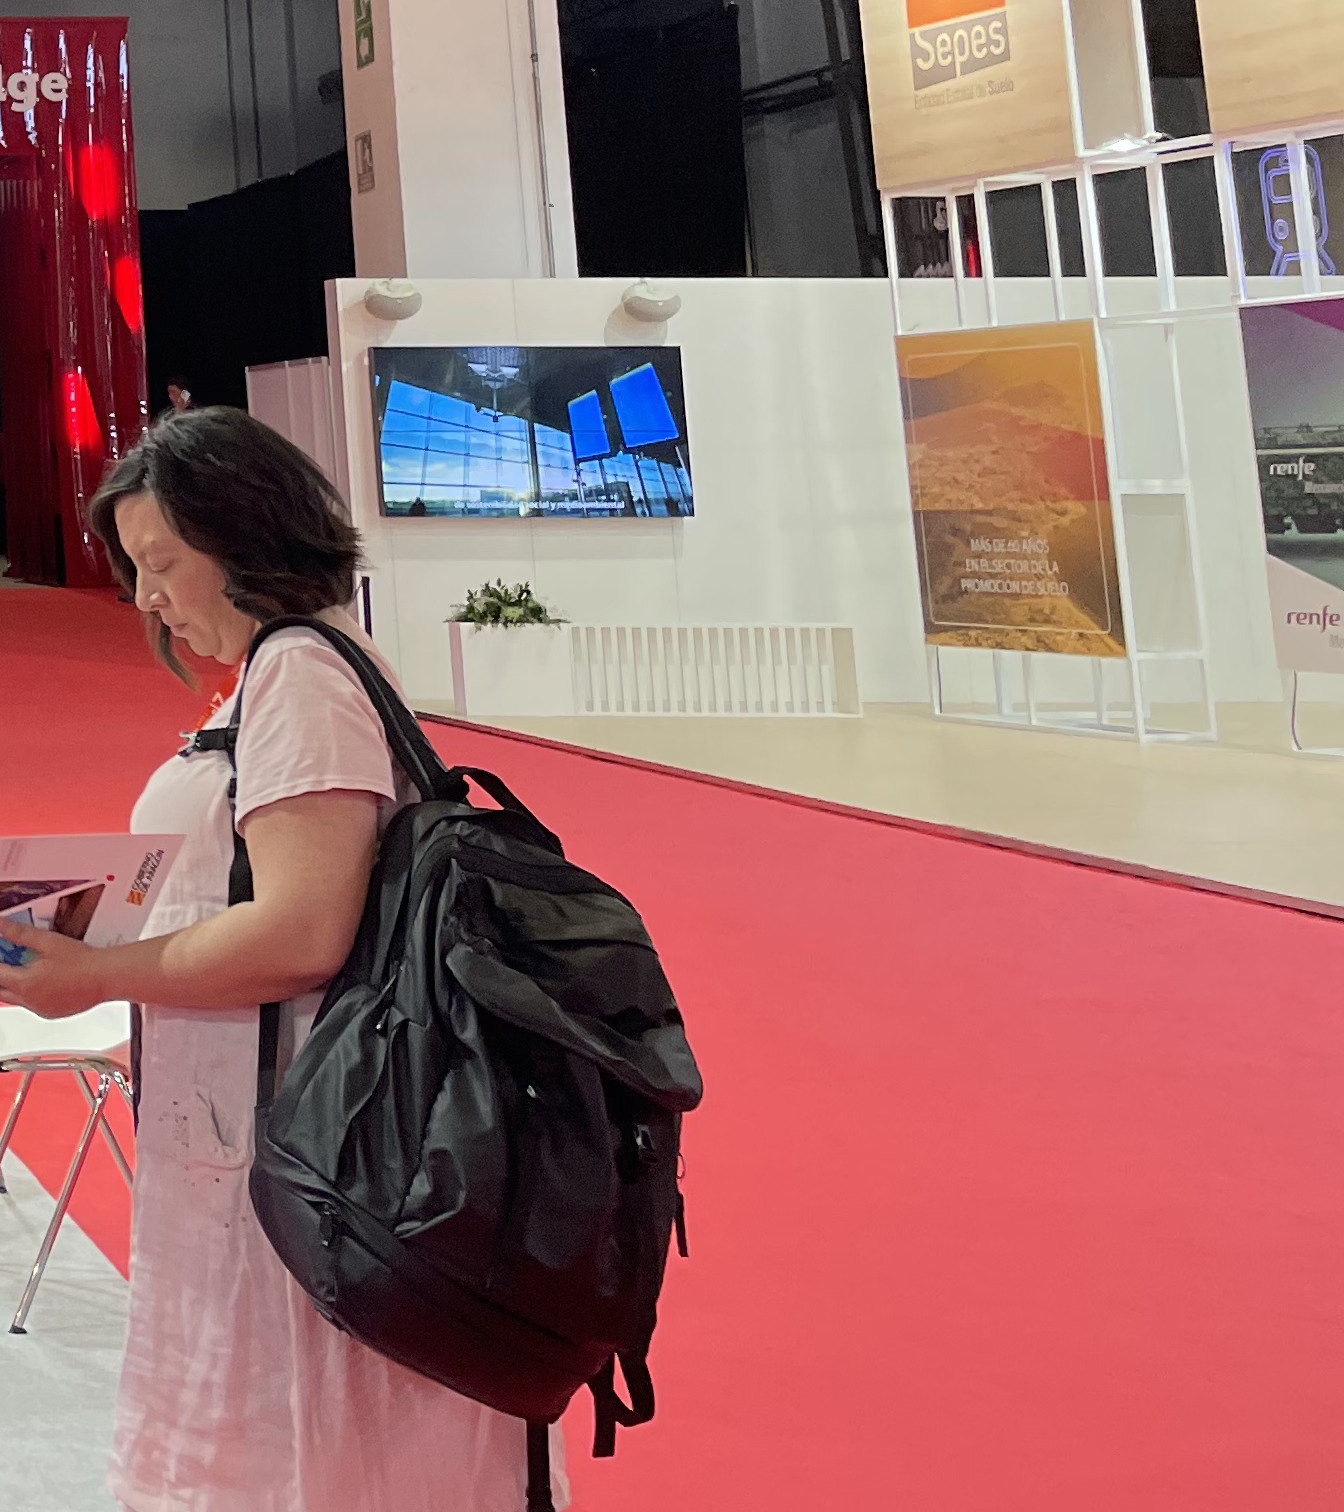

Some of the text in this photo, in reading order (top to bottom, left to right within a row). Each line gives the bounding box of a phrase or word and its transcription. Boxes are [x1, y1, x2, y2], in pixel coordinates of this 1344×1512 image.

[914, 20, 1007, 78] Sepes
[1269, 456, 1316, 481] renfe
[1286, 604, 1341, 634] renfe
